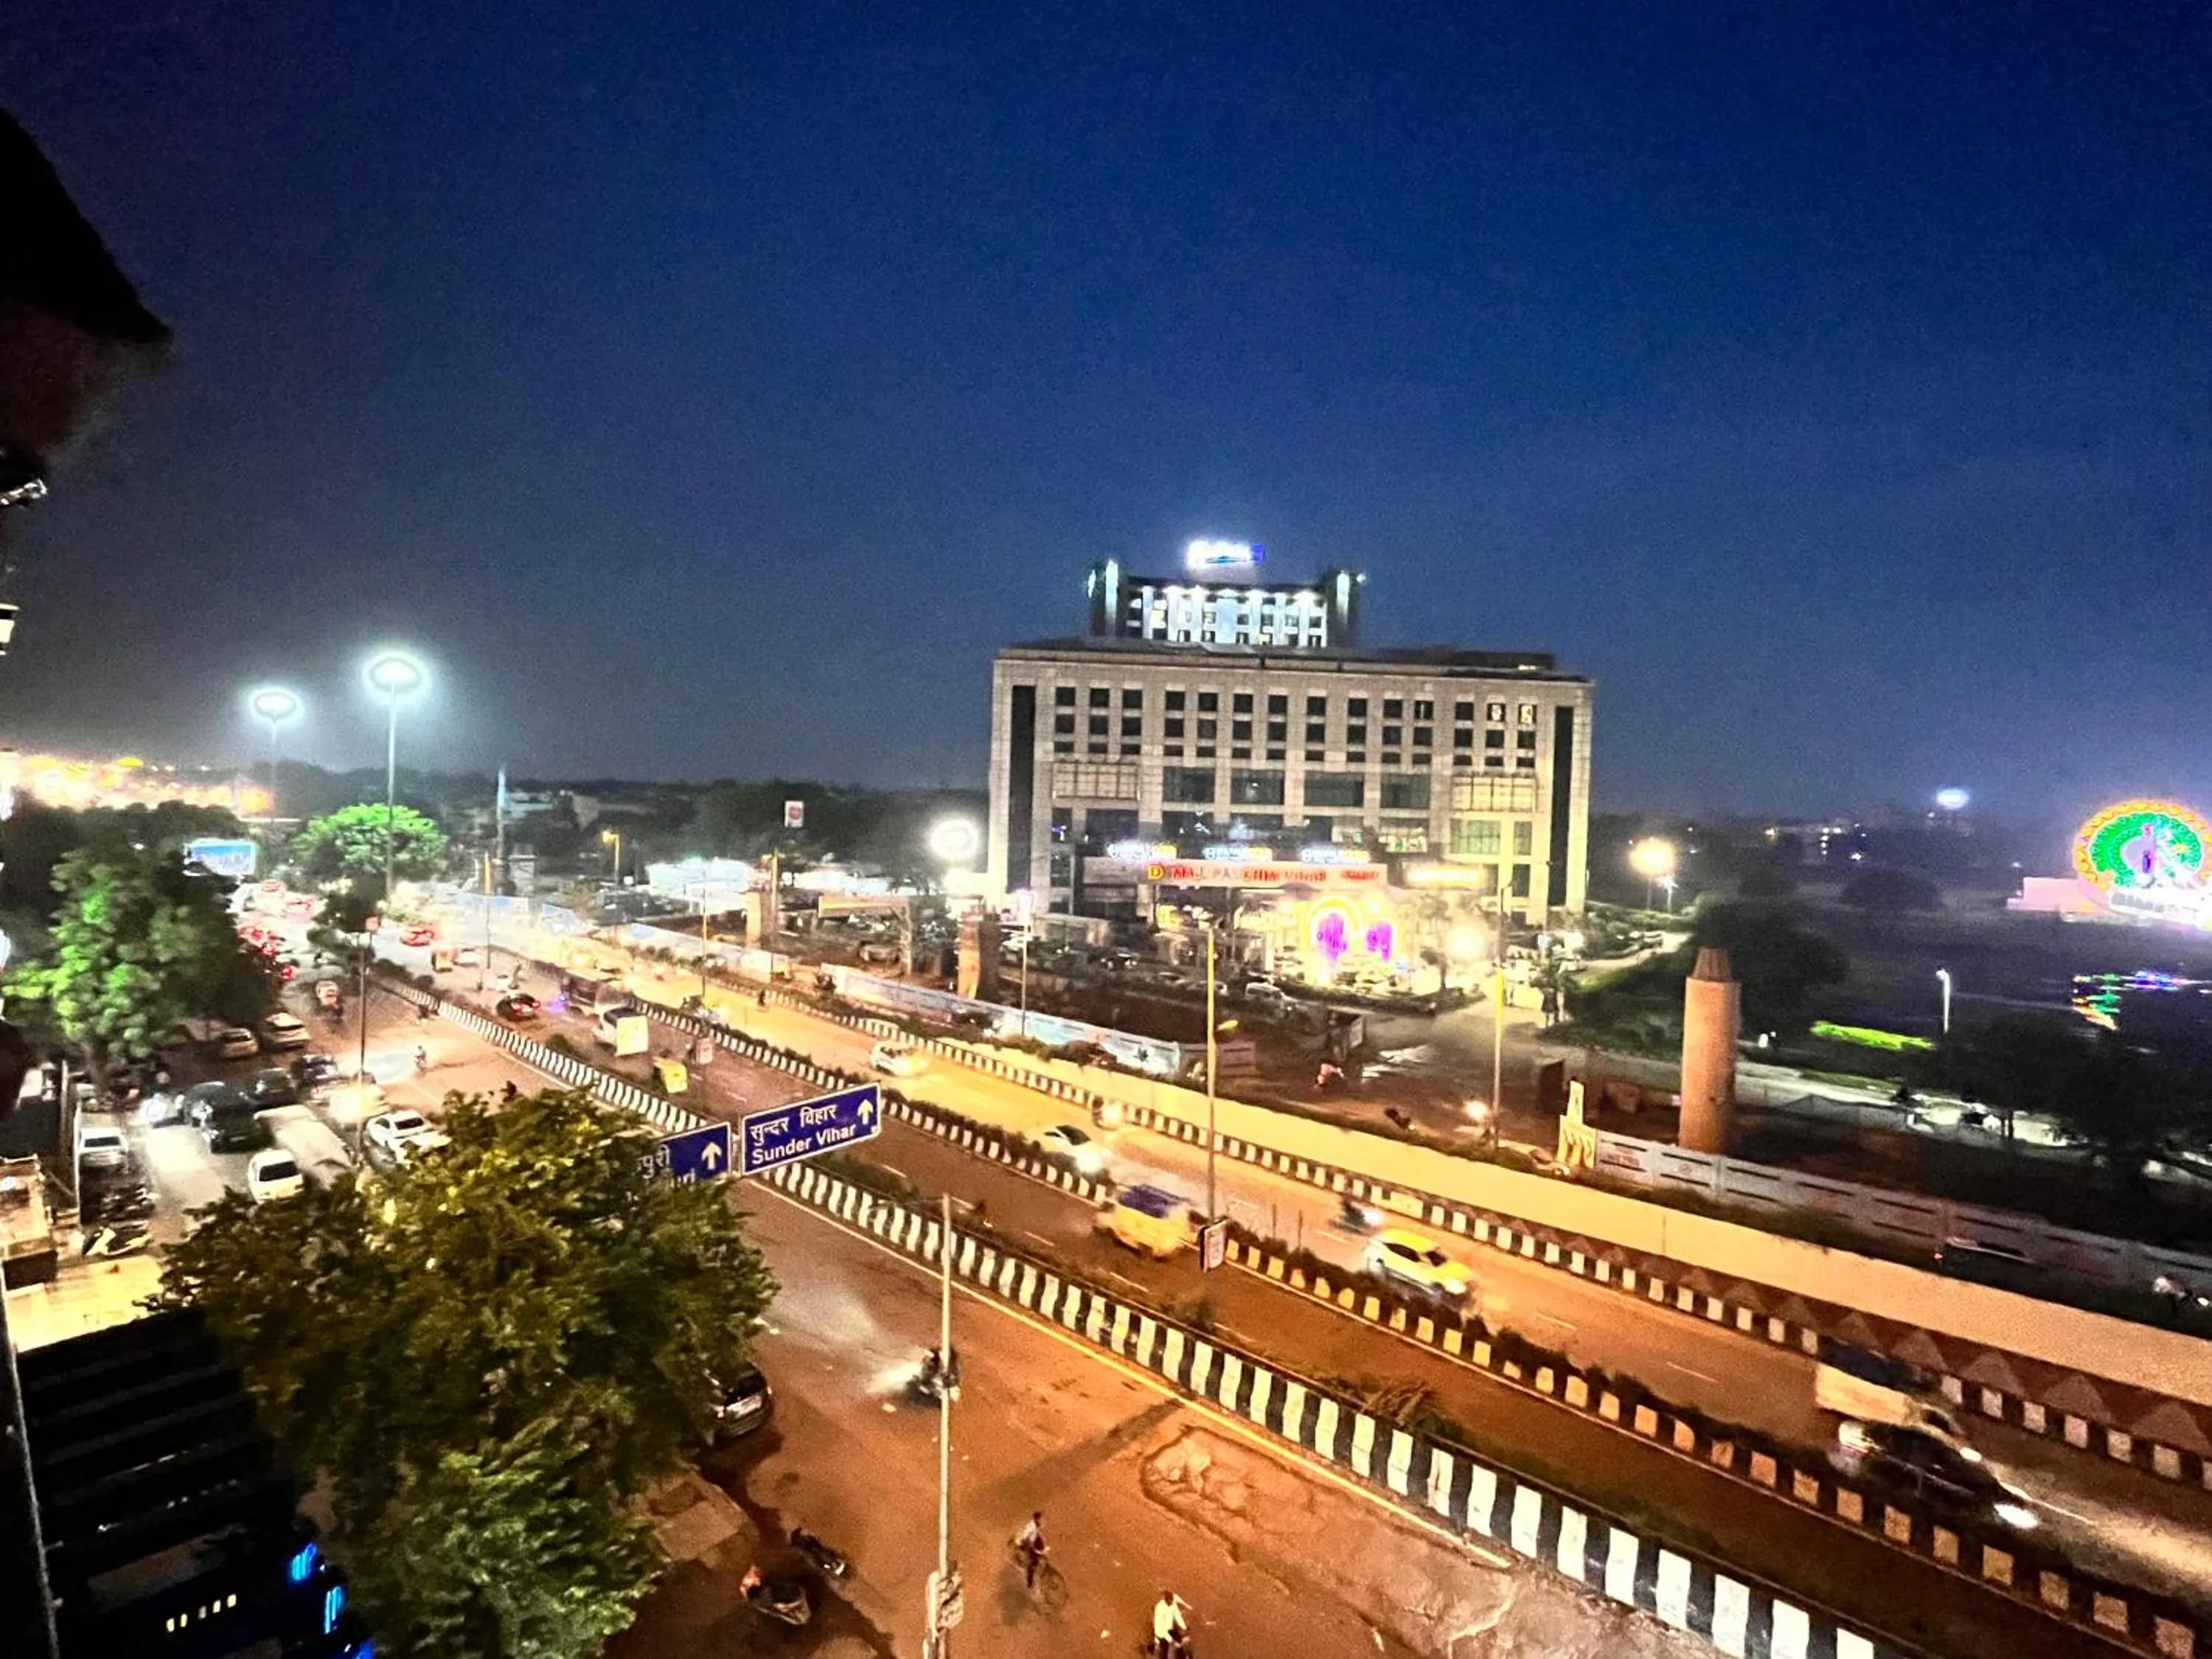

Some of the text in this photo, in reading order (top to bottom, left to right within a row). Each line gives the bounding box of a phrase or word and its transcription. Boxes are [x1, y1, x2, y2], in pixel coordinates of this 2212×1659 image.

[749, 1104, 838, 1147] सुन्दर विहार
[751, 1124, 856, 1164] Sunder Vihar
